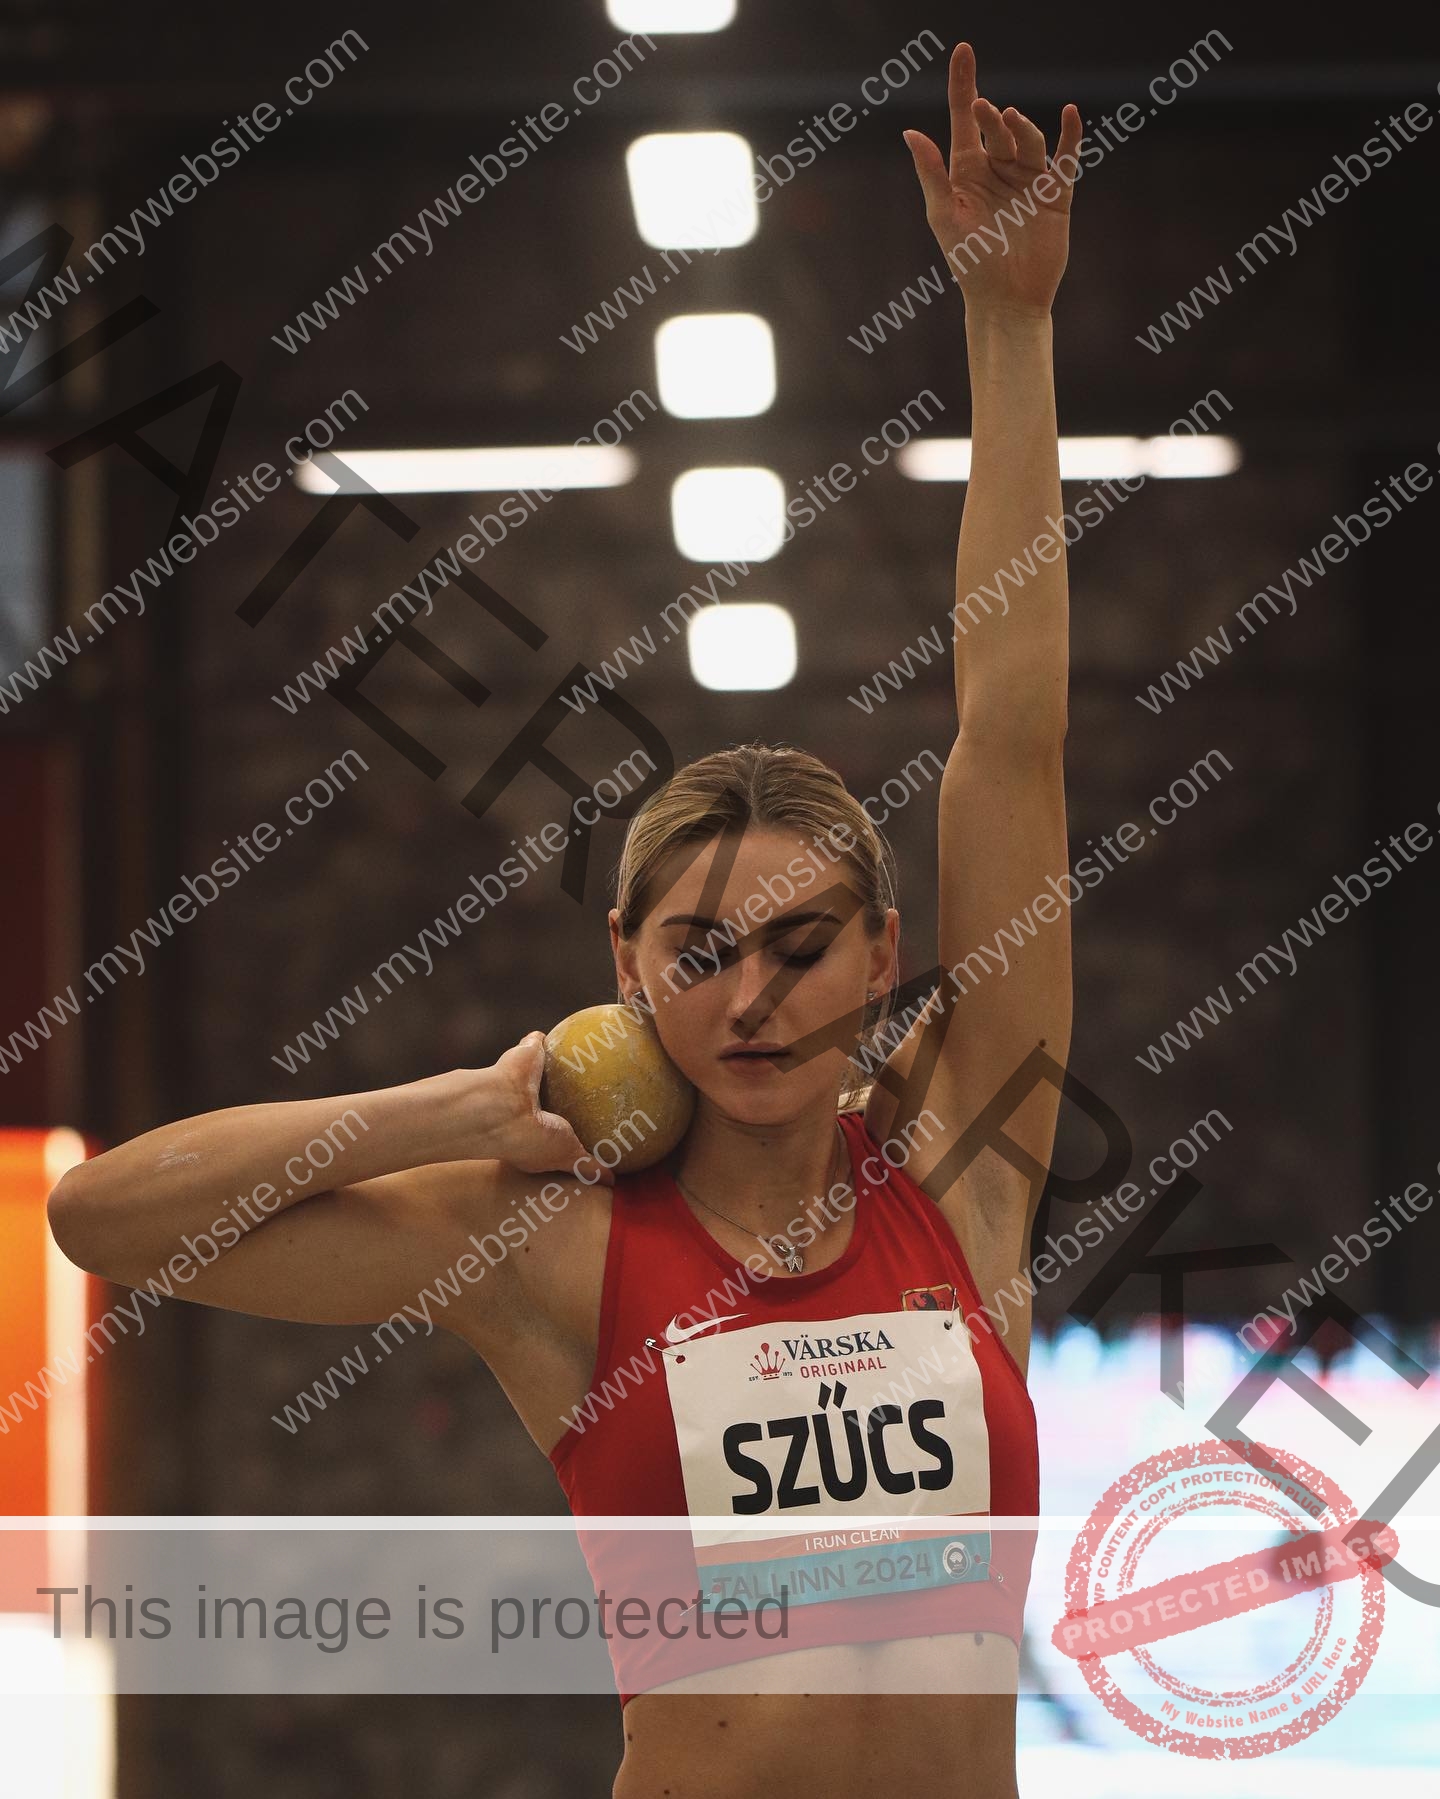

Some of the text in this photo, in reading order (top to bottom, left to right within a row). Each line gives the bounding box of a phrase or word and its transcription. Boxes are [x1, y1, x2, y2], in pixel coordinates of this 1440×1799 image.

[782, 1330, 895, 1360] VÄRSKA
[800, 1356, 887, 1379] ORIGINAAL
[722, 1380, 954, 1515] SZŰCS
[812, 1533, 847, 1550] RUN
[850, 1527, 900, 1545] CLEAN
[711, 1563, 846, 1602] TALLINN
[854, 1552, 931, 1586] 2024
